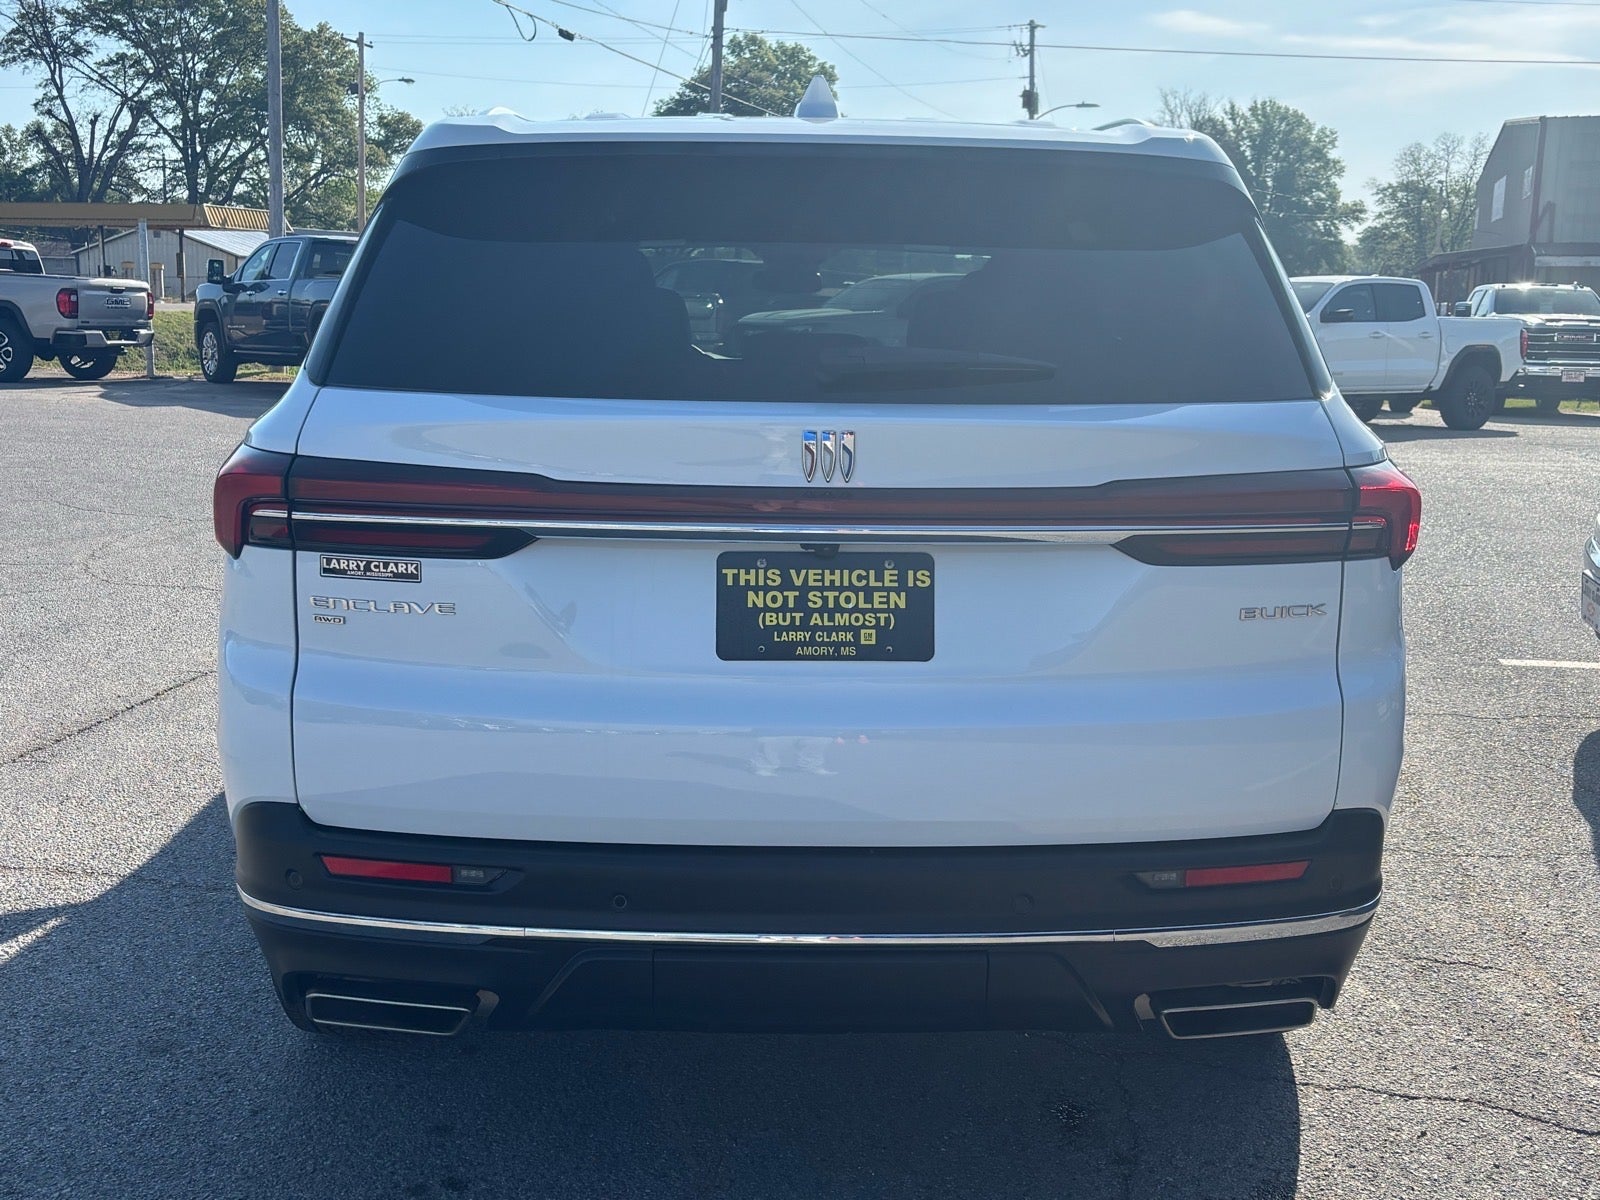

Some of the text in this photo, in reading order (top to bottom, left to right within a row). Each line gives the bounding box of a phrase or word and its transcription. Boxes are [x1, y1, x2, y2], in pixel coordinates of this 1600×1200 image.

[322, 558, 418, 574] LARRY CLARK
[722, 569, 931, 588] THIS VEHICLE IS
[747, 591, 906, 609] NOT STOLEN
[314, 616, 342, 624] AWD
[1239, 603, 1327, 621] BUICK
[758, 613, 895, 630] (BUT ALMOST)
[774, 631, 812, 642] LARRY
[815, 631, 855, 642] CLARK
[795, 646, 856, 656] AMORY, MS
